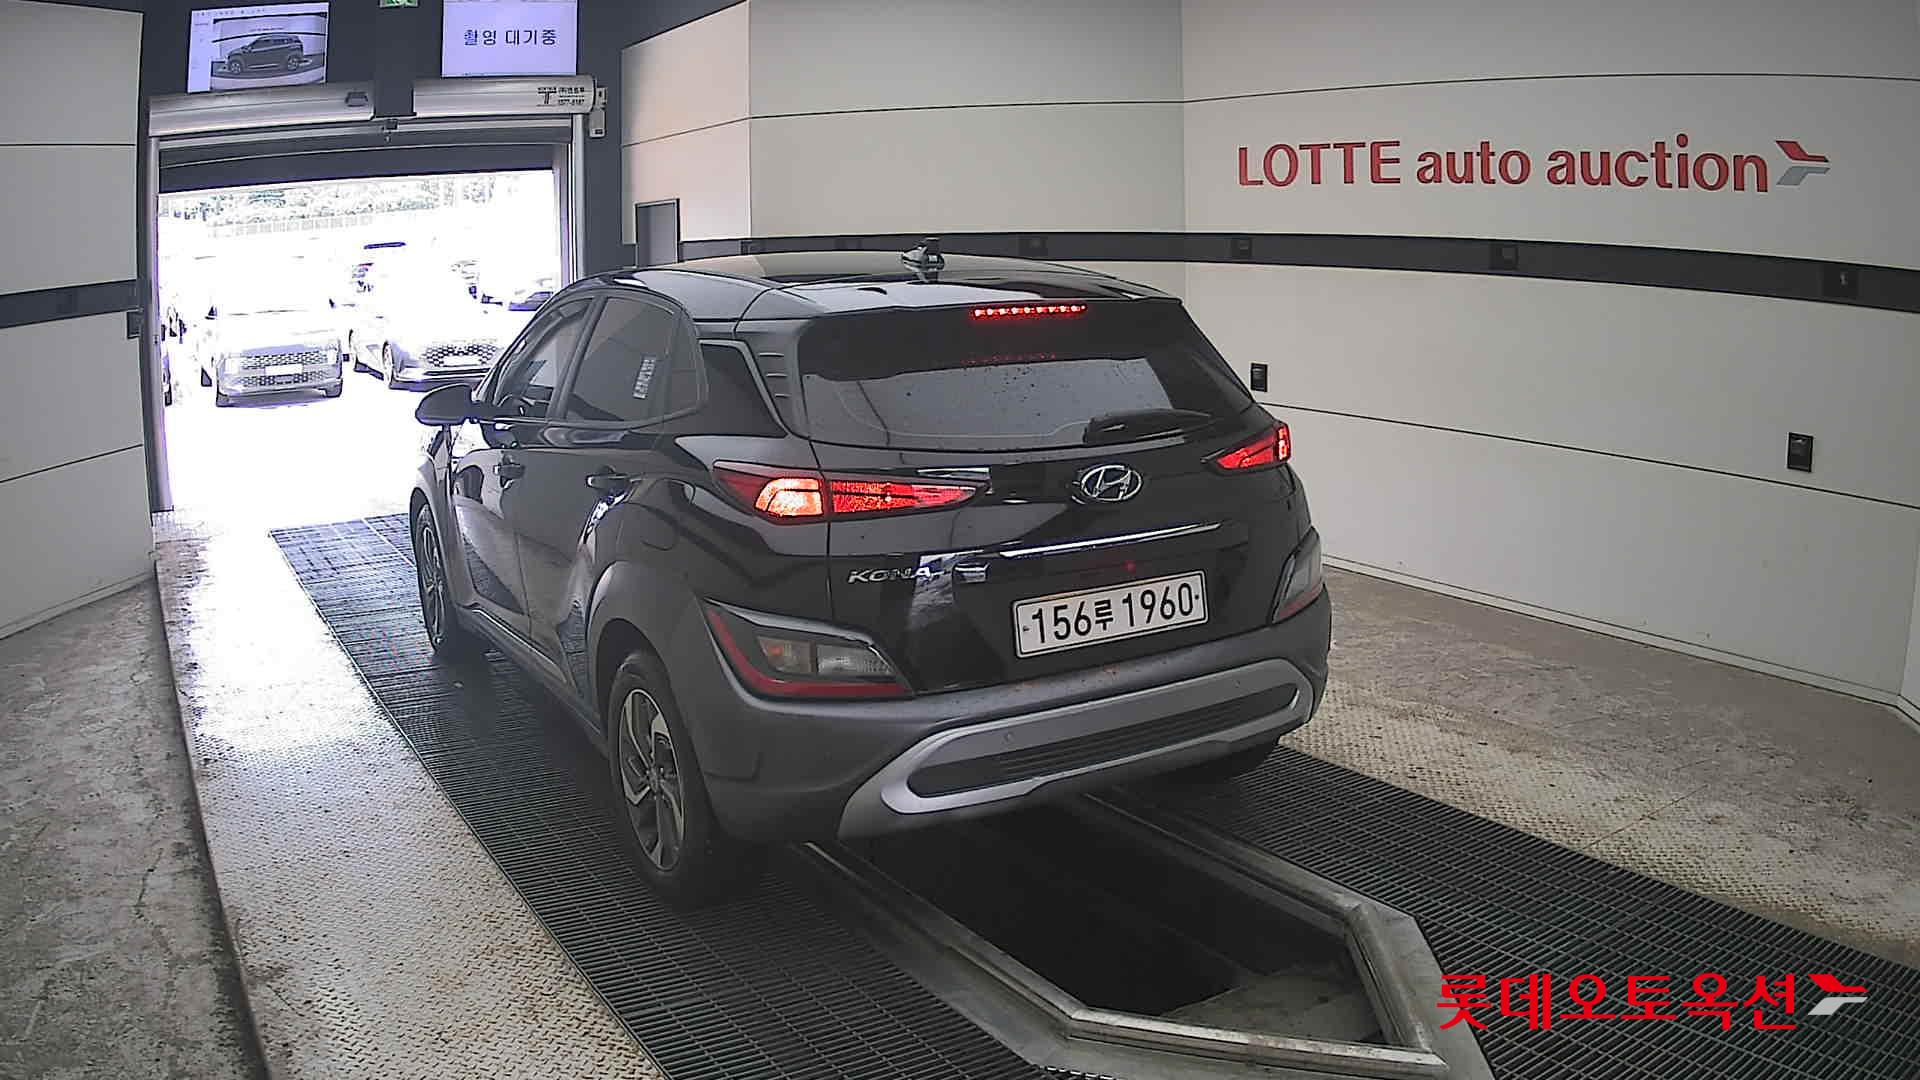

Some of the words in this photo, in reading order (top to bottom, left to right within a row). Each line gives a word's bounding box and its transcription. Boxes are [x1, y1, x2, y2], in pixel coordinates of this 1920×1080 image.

[505, 29, 557, 46] 대기중
[1238, 142, 1398, 188] LOTTE
[1417, 142, 1532, 185] auto
[1547, 135, 1769, 191] auction
[848, 566, 931, 583] KONA
[1031, 598, 1114, 644] 156루
[1121, 582, 1194, 628] 1960
